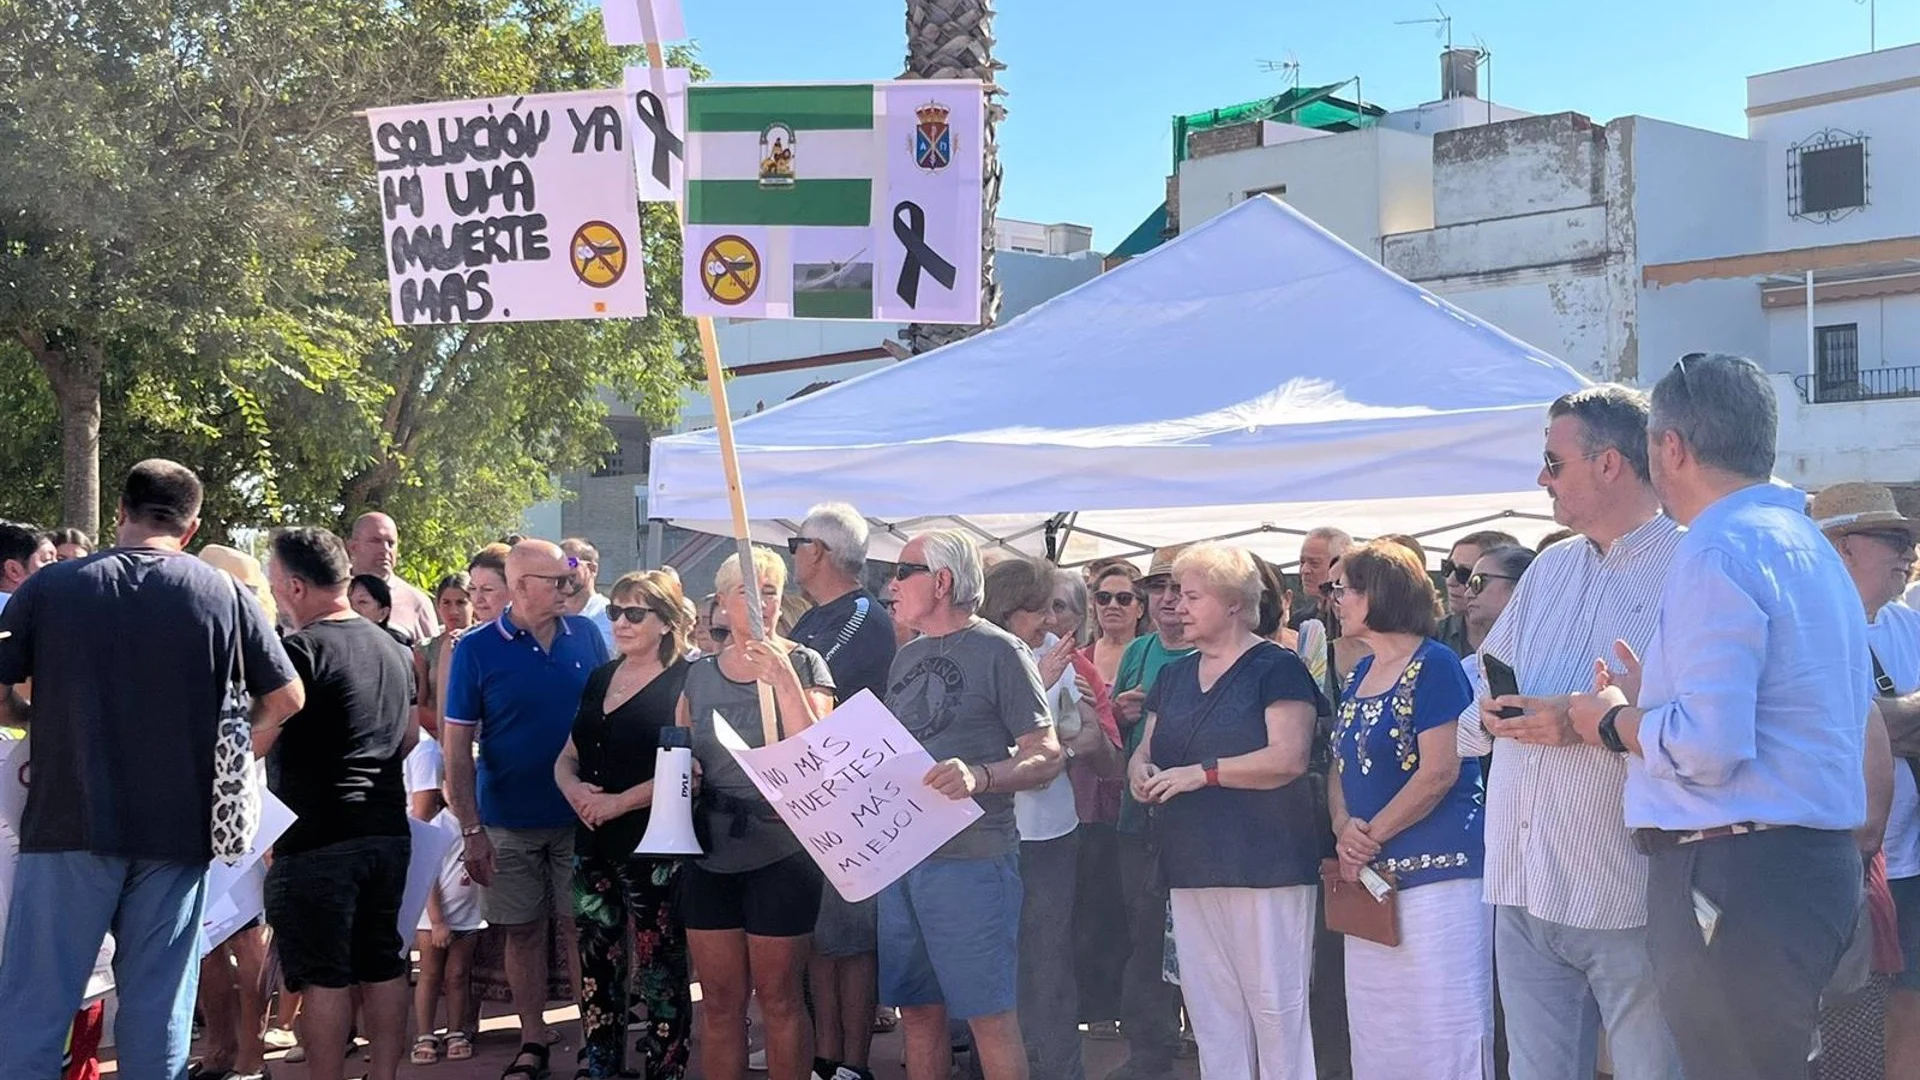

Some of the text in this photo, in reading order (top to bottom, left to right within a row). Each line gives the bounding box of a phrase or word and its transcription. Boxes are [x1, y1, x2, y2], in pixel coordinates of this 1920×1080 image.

[566, 105, 623, 154] YA
[383, 160, 535, 221] NI UNA
[391, 213, 551, 275] MUERTE
[851, 781, 901, 828] MÁS
